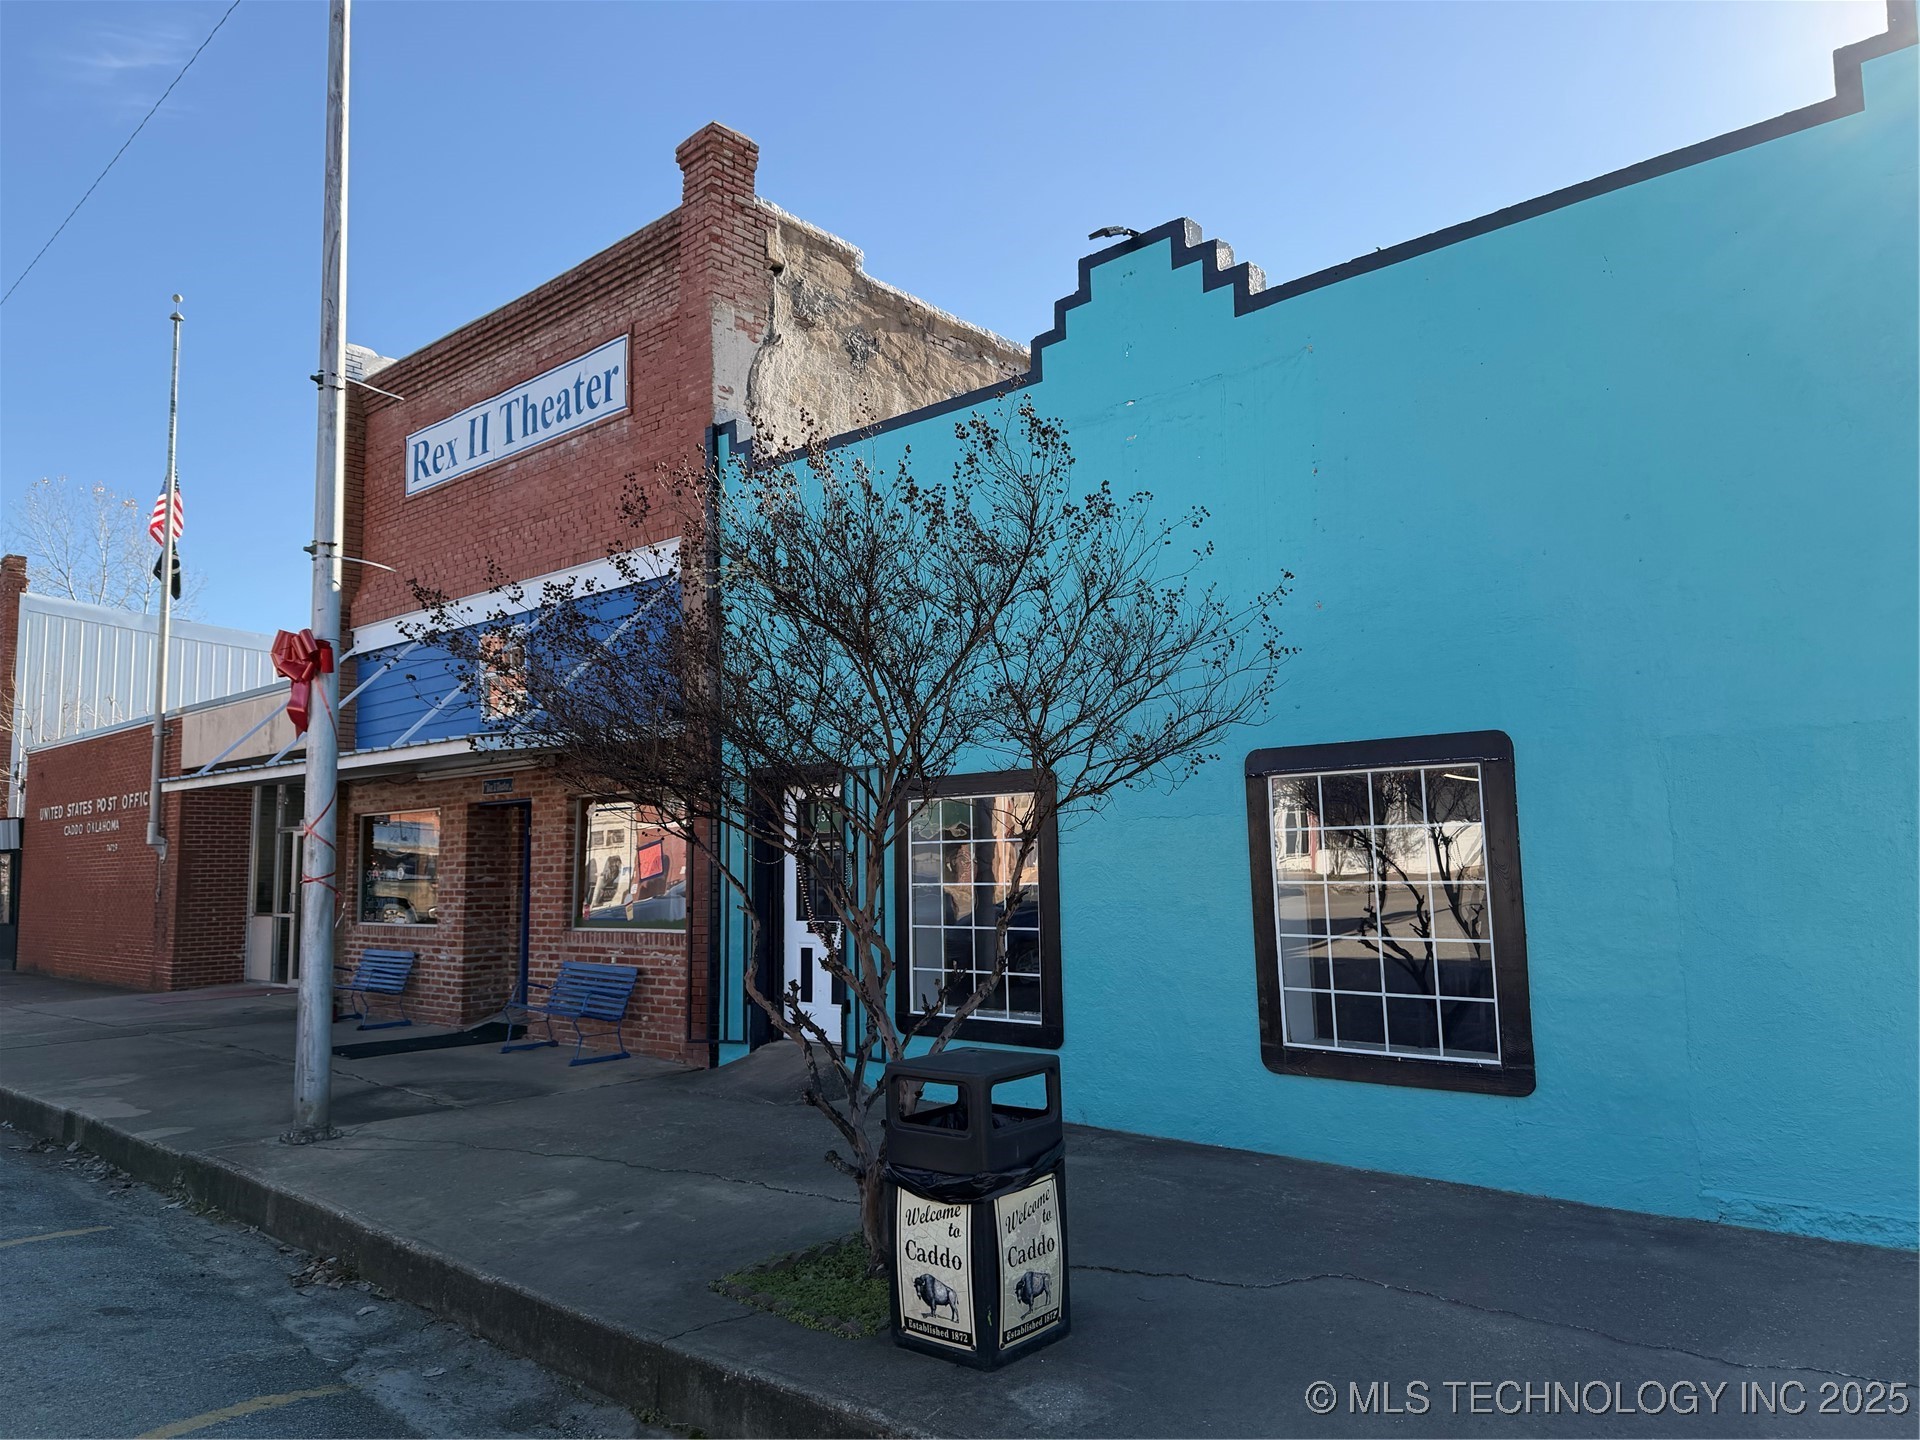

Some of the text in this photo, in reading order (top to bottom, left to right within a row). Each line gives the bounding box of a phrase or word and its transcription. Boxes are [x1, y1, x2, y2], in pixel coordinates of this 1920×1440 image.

[411, 365, 619, 484] Rex II Theater
[40, 791, 151, 821] UNITED STATES POST OFFIC
[64, 820, 120, 836] CADDO OKLAHOMA
[905, 1204, 962, 1227] Welcome
[1005, 1188, 1051, 1235] Welcome
[1042, 1208, 1052, 1224] to
[948, 1222, 962, 1239] to
[904, 1239, 963, 1271] Caddo
[1007, 1234, 1056, 1268] Caddo
[908, 1318, 969, 1343] Established 1872
[1006, 1317, 1042, 1341] Established
